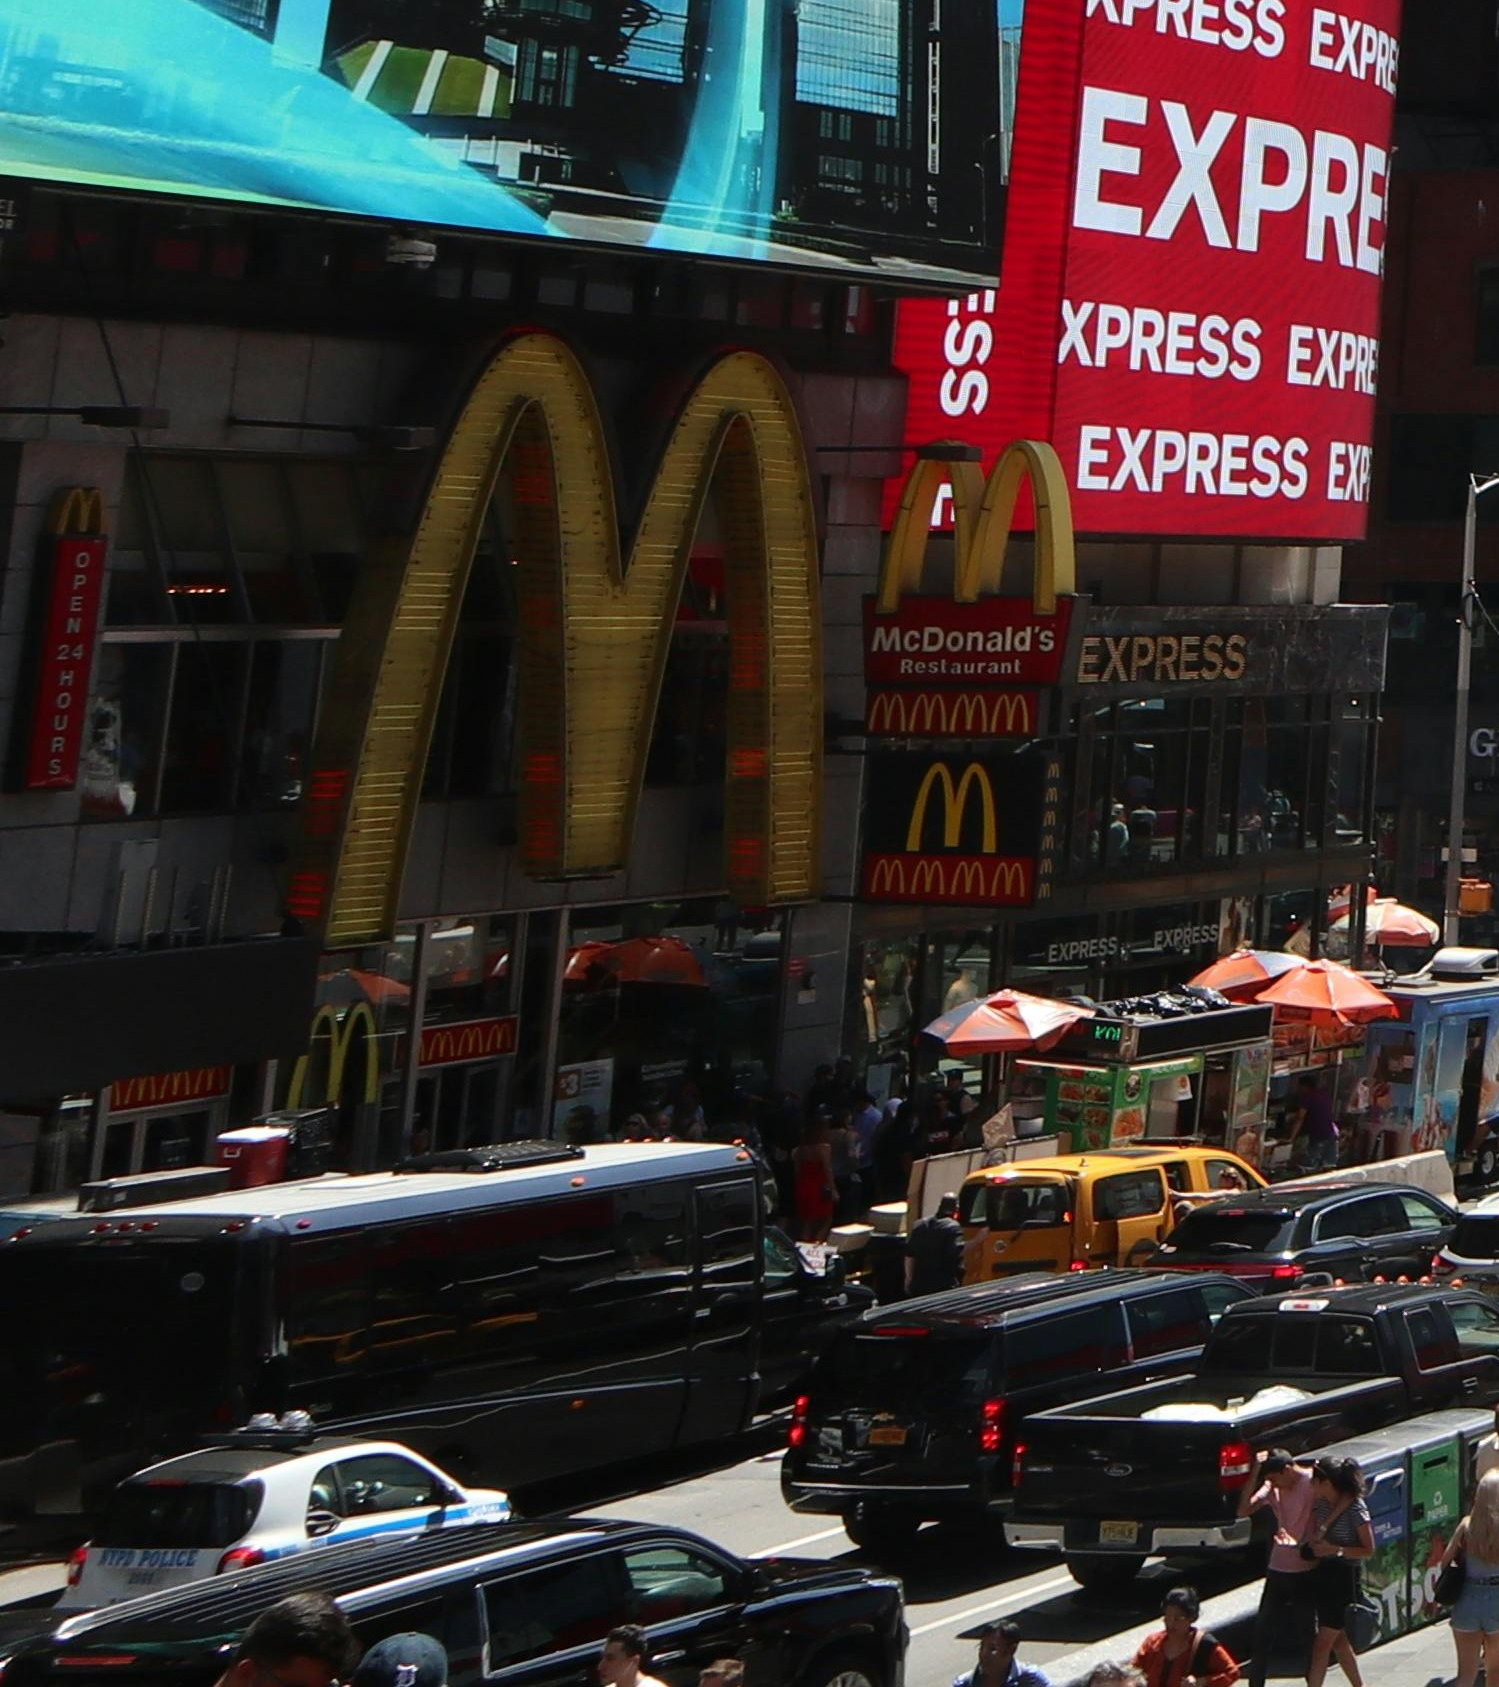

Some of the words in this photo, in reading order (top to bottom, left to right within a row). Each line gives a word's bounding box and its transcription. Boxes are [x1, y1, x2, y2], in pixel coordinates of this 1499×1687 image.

[1309, 8, 1398, 95] EXPRE
[1073, 85, 1389, 277] EXPRE
[1287, 323, 1377, 395] EXPRE
[1076, 425, 1308, 500] EXPRESS
[66, 552, 90, 633] OPEN
[56, 643, 84, 661] 24
[872, 625, 1055, 653] McDonald's
[901, 657, 1021, 676] Restaurant
[1078, 634, 1247, 683] EXPRESS
[49, 669, 74, 776] HOURS
[1047, 938, 1118, 965] EXPRESS
[1153, 923, 1220, 951] EXPRESS
[138, 1549, 199, 1568] POLICE
